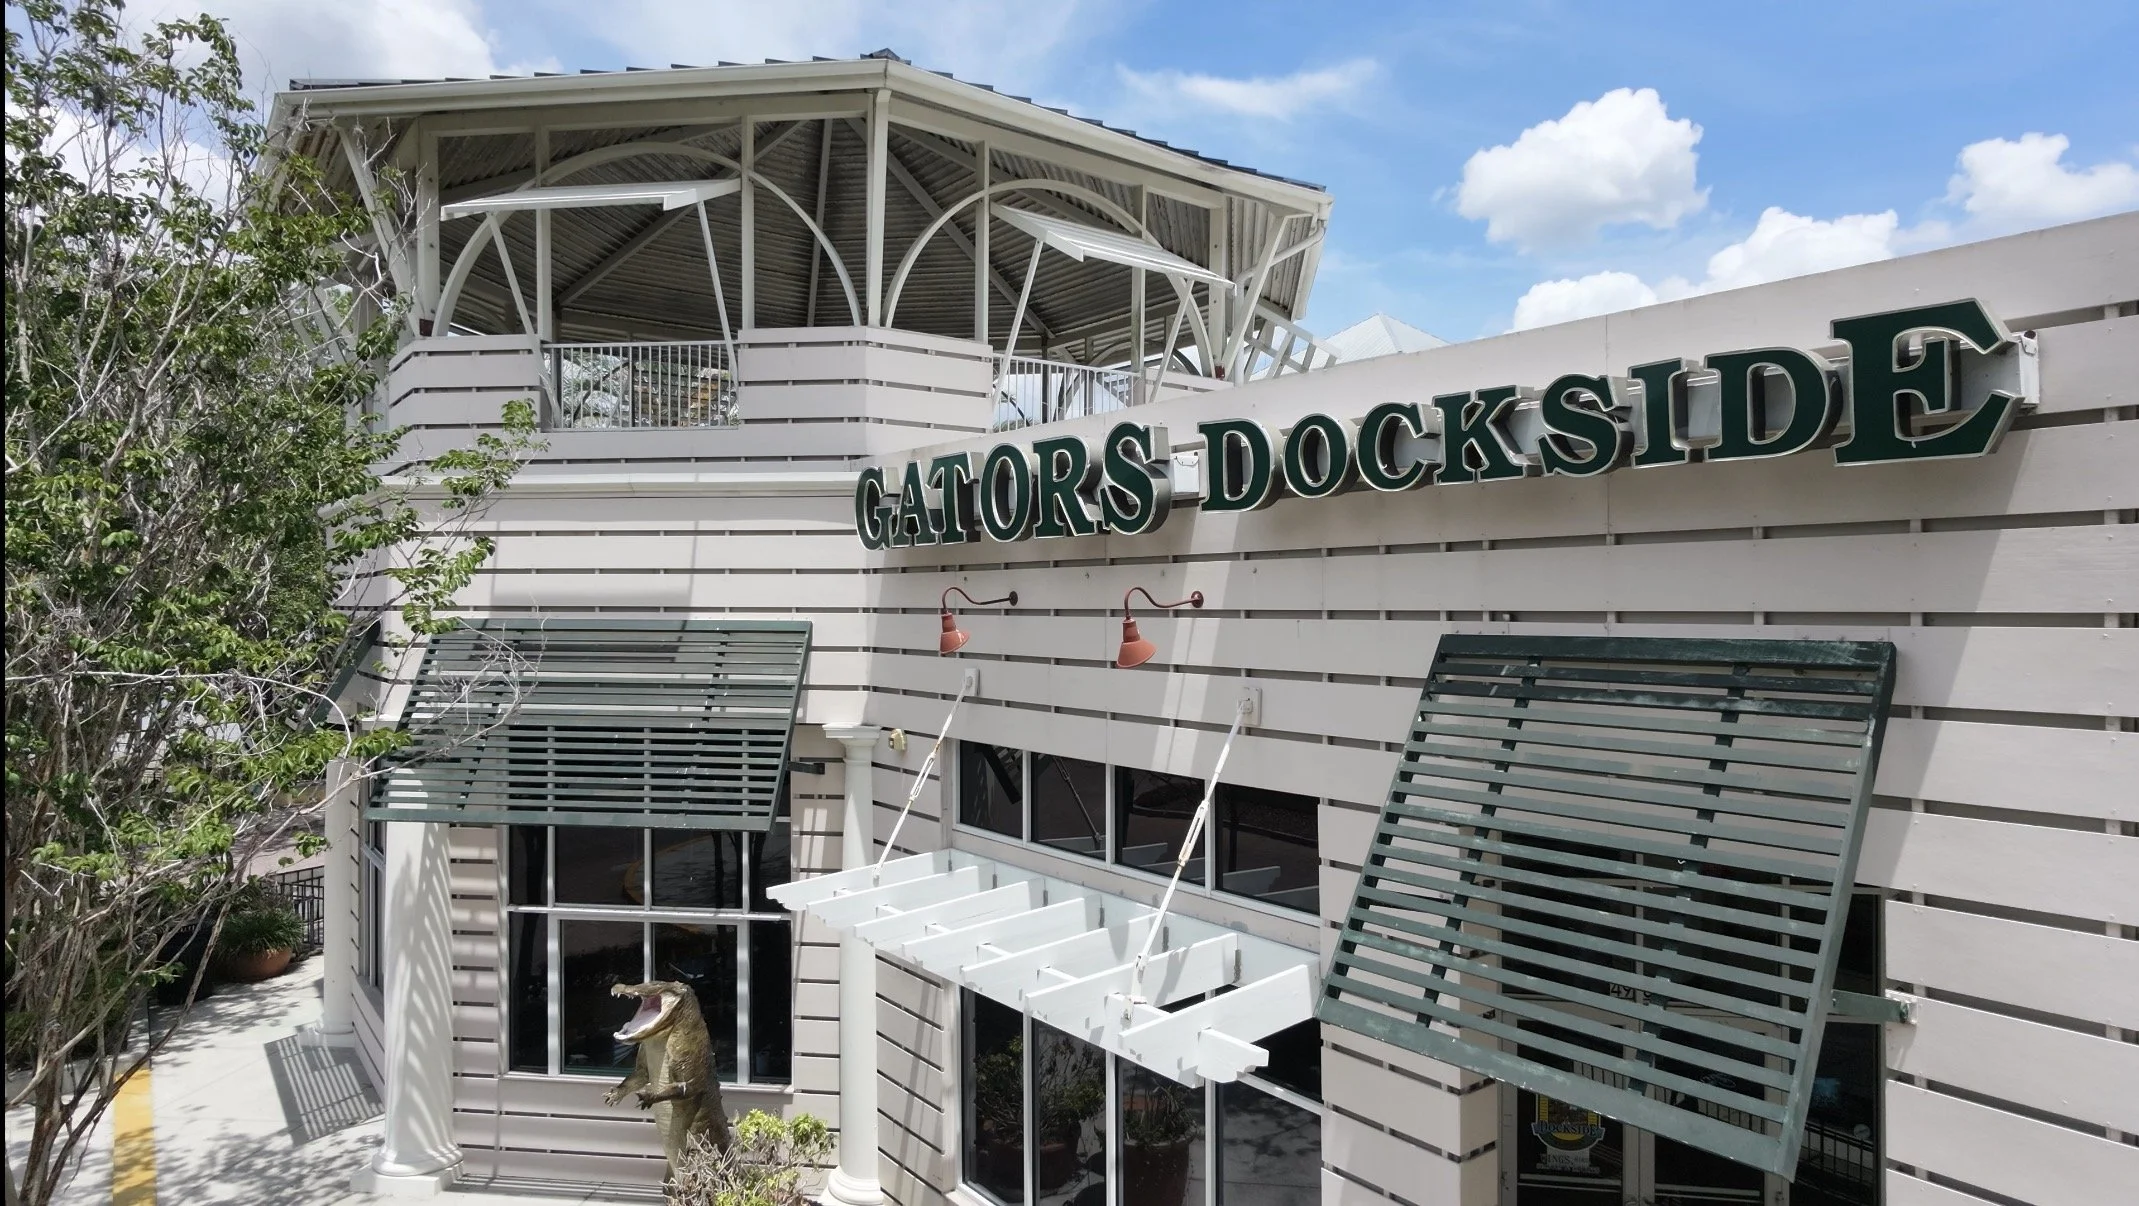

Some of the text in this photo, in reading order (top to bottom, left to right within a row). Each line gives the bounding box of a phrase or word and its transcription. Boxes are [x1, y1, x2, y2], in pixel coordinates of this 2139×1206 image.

[855, 297, 2020, 551] GATORS DOCKSIDE
[1539, 1120, 1598, 1137] DOCKSIDE
